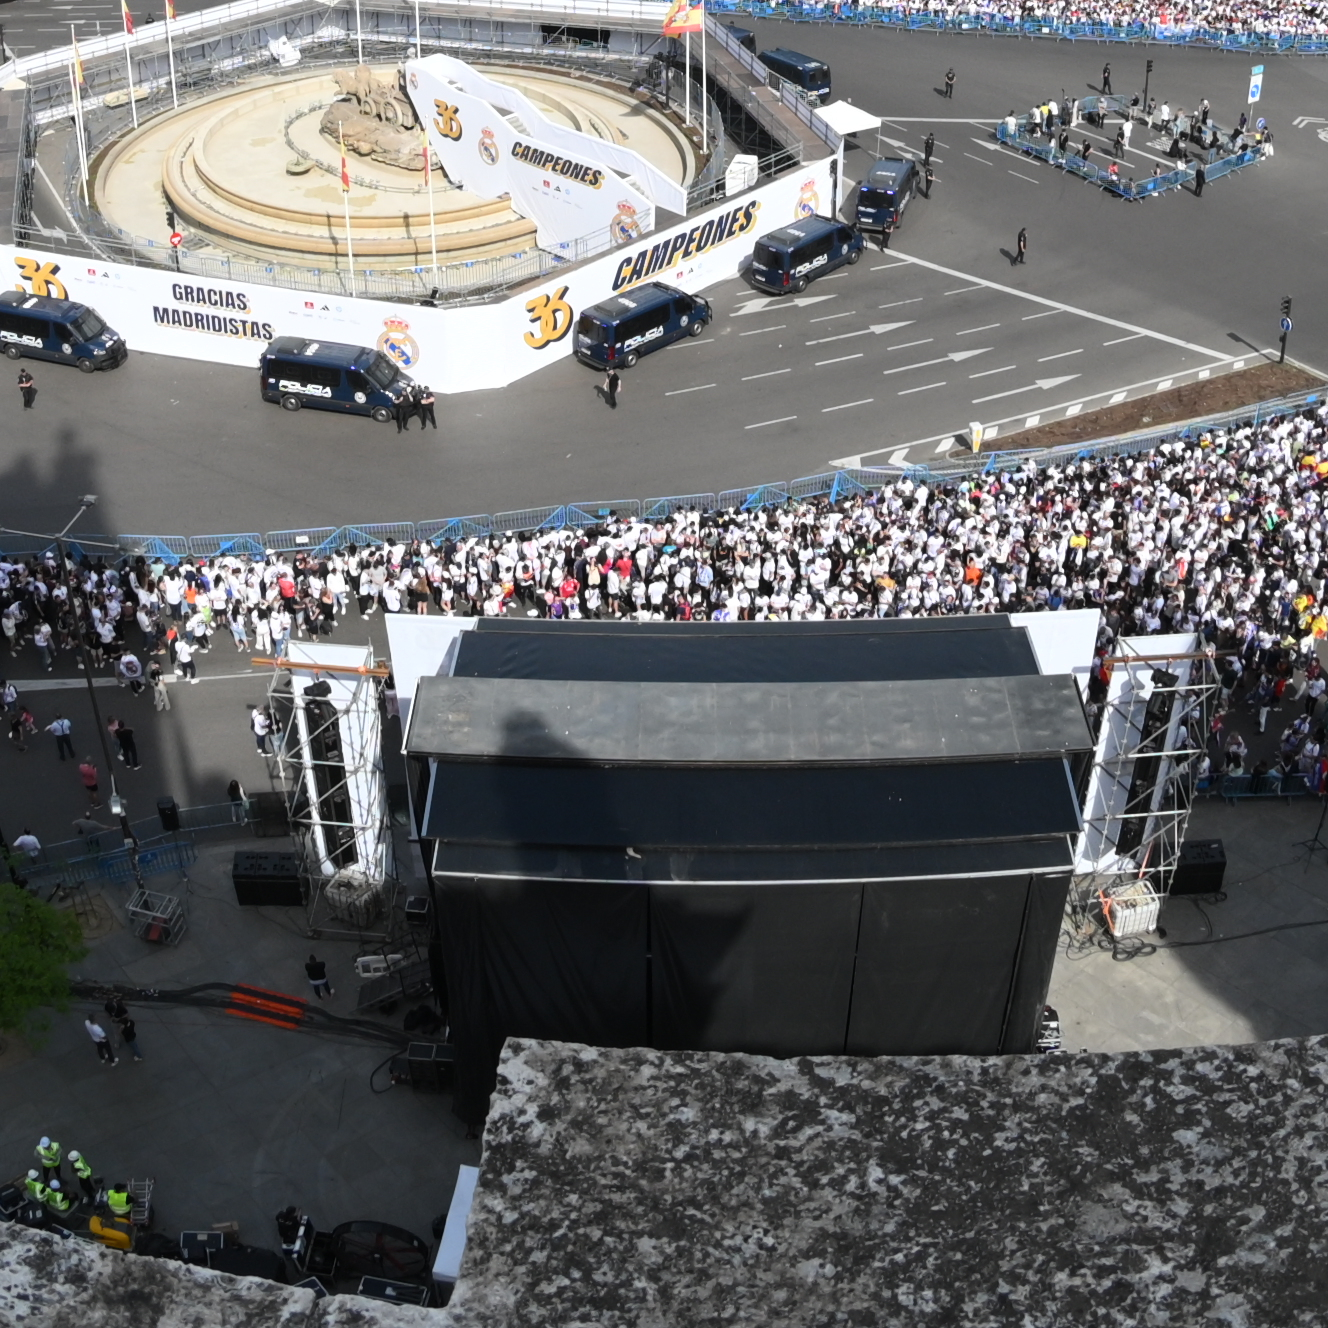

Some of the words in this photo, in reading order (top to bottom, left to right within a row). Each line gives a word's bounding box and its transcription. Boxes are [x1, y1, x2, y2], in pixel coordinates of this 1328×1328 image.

[433, 98, 463, 142] 36
[511, 141, 603, 187] CAMPEONES
[612, 201, 758, 292] CAMPEONES
[172, 283, 249, 312] GRACIAS
[524, 286, 573, 349] 36
[152, 305, 274, 343] MADRIDISTAS
